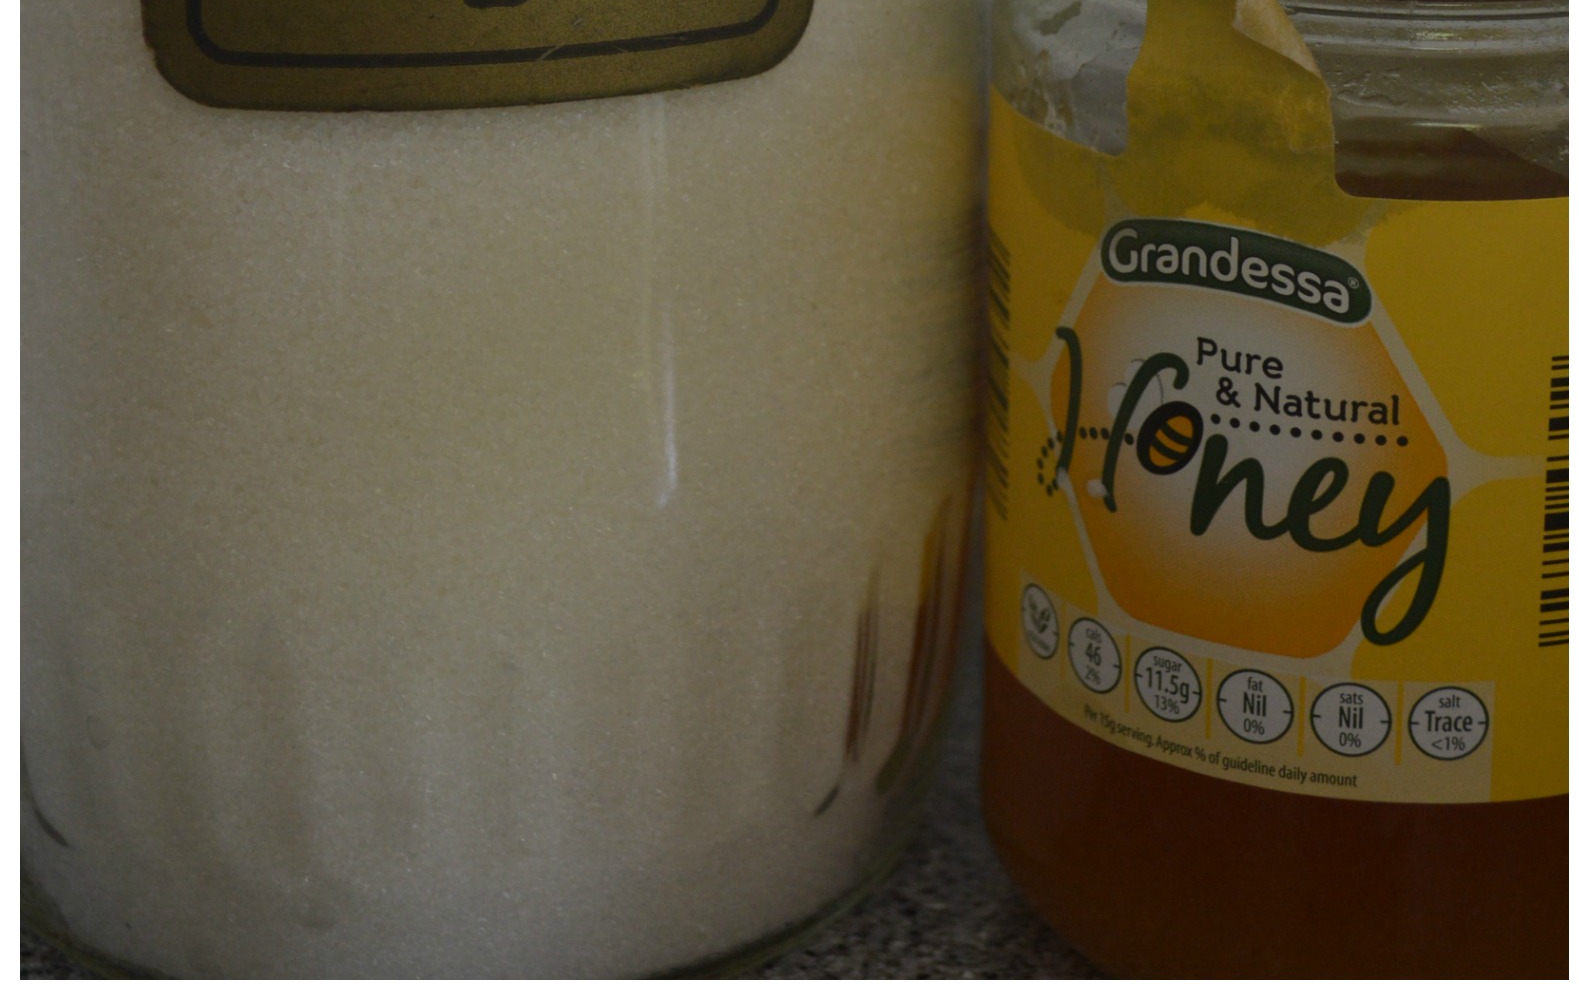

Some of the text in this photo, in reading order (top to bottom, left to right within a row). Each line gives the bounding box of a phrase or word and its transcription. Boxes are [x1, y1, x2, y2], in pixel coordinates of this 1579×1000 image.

[1108, 227, 1350, 315] Grandessa
[1196, 336, 1284, 380] Pure
[1215, 378, 1401, 425] & Natural
[1056, 326, 1451, 647] Honey
[1085, 642, 1102, 667] 46
[1152, 655, 1183, 674] sugar
[1146, 667, 1190, 704] 11.5g
[1247, 677, 1264, 693] fat
[1154, 694, 1180, 716] 13%
[1242, 692, 1267, 717] Nil
[1339, 691, 1364, 705] sats
[1438, 694, 1461, 709] salt
[1243, 718, 1265, 736] 0%
[1338, 706, 1364, 730] Nil
[1425, 710, 1473, 733] Trace
[1339, 731, 1362, 749] 0%
[1431, 736, 1466, 751] <1%
[1155, 735, 1193, 757] Approx
[1194, 746, 1206, 762] %
[1208, 751, 1221, 765] of
[1222, 754, 1276, 777] guideline
[1278, 764, 1307, 785] daily
[1309, 773, 1358, 788] amount
